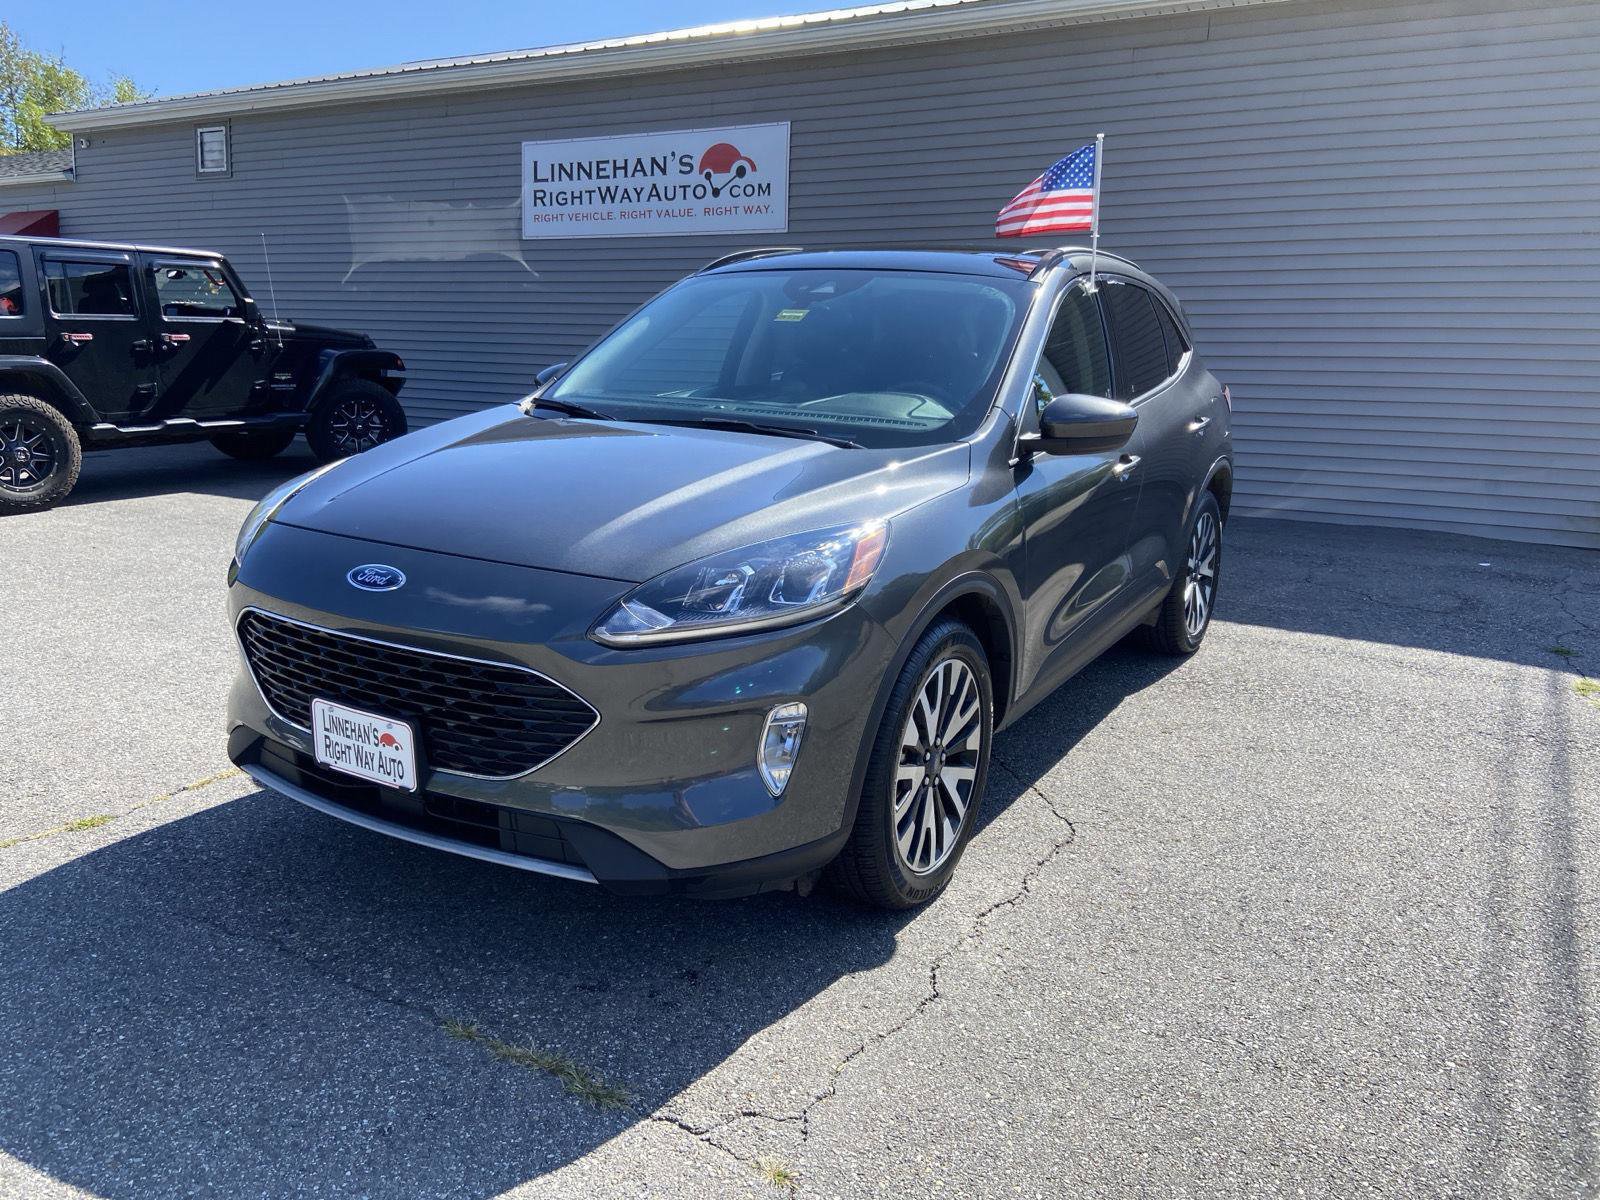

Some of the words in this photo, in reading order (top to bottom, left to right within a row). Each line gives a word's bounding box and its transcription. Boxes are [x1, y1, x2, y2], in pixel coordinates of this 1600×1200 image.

[533, 151, 695, 183] LINNEHAN'S
[533, 213, 565, 223] RIGHT
[567, 211, 616, 221] VEHICLE.
[620, 209, 653, 220] RIGHT
[656, 208, 697, 219] VALUE.
[703, 206, 740, 217] RIGHT
[743, 204, 774, 215] WAY.
[357, 567, 391, 585] Ford
[322, 708, 380, 748] LINNEHAN'S
[324, 734, 352, 764] RIGHT
[353, 743, 375, 772] WAY
[378, 750, 405, 780] AUTO
